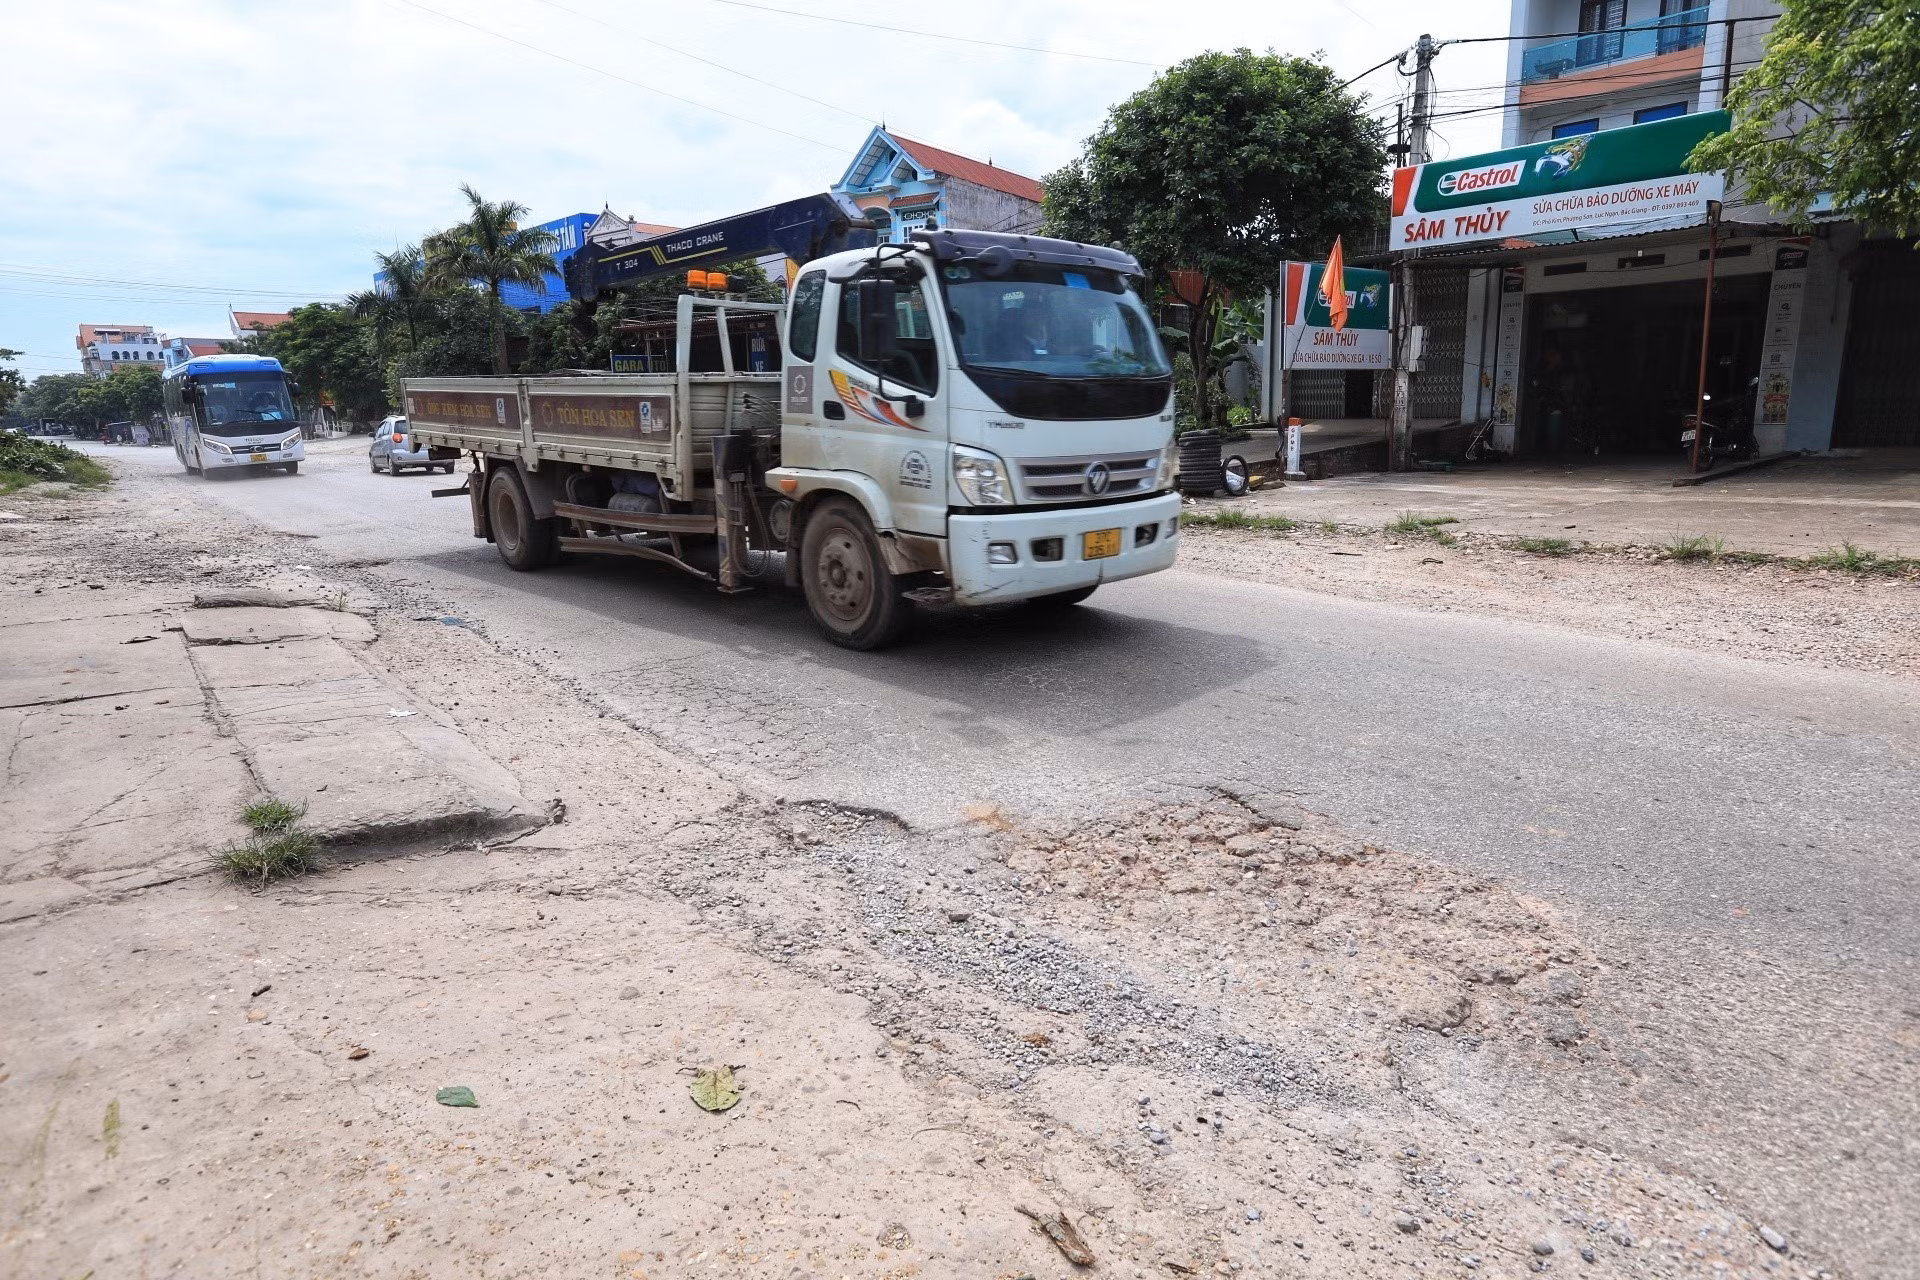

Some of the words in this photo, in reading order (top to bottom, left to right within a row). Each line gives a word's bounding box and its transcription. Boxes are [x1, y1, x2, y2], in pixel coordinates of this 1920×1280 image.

[1457, 164, 1519, 191] Castrol
[1532, 198, 1553, 214] SỬA
[1554, 195, 1584, 211] CHỮA
[1586, 191, 1609, 207] BẢO
[1611, 187, 1653, 204] DƯỠNG
[1655, 185, 1671, 198] XE
[1673, 179, 1700, 196] MÁY
[1661, 202, 1676, 211] 0397
[1404, 217, 1445, 243] SÂM
[1454, 206, 1511, 236] THỦY
[666, 240, 693, 253] THACO
[696, 231, 724, 247] CRANE
[616, 262, 621, 271] T
[624, 258, 639, 269] 304
[1313, 329, 1333, 346] SÂM
[1336, 329, 1359, 347] THỦY
[614, 359, 645, 372] GARA
[557, 402, 580, 425] TÔN
[581, 408, 608, 427] HOA
[609, 409, 636, 428] SEN
